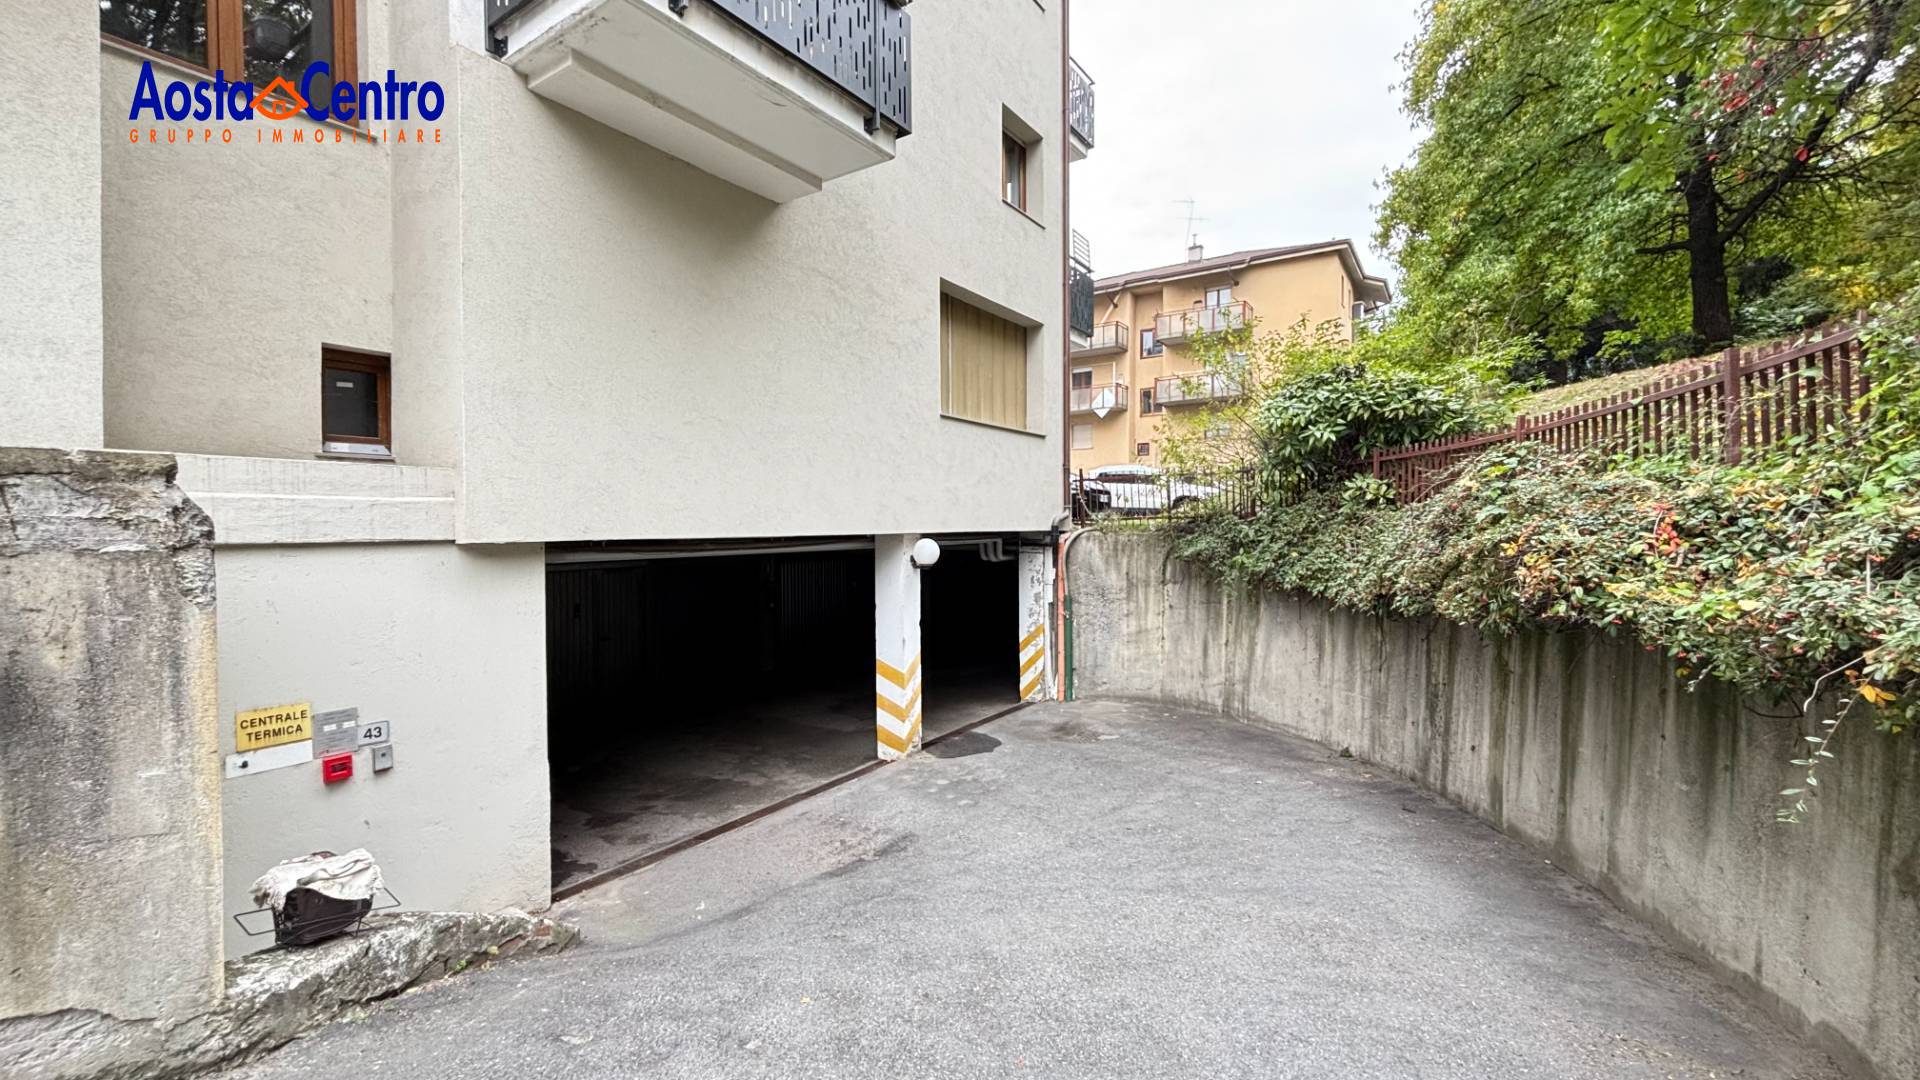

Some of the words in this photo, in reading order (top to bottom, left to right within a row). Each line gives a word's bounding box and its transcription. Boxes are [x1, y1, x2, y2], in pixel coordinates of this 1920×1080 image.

[240, 709, 308, 730] CENTRALE
[246, 723, 303, 742] TERMICA
[363, 726, 382, 740] 43
